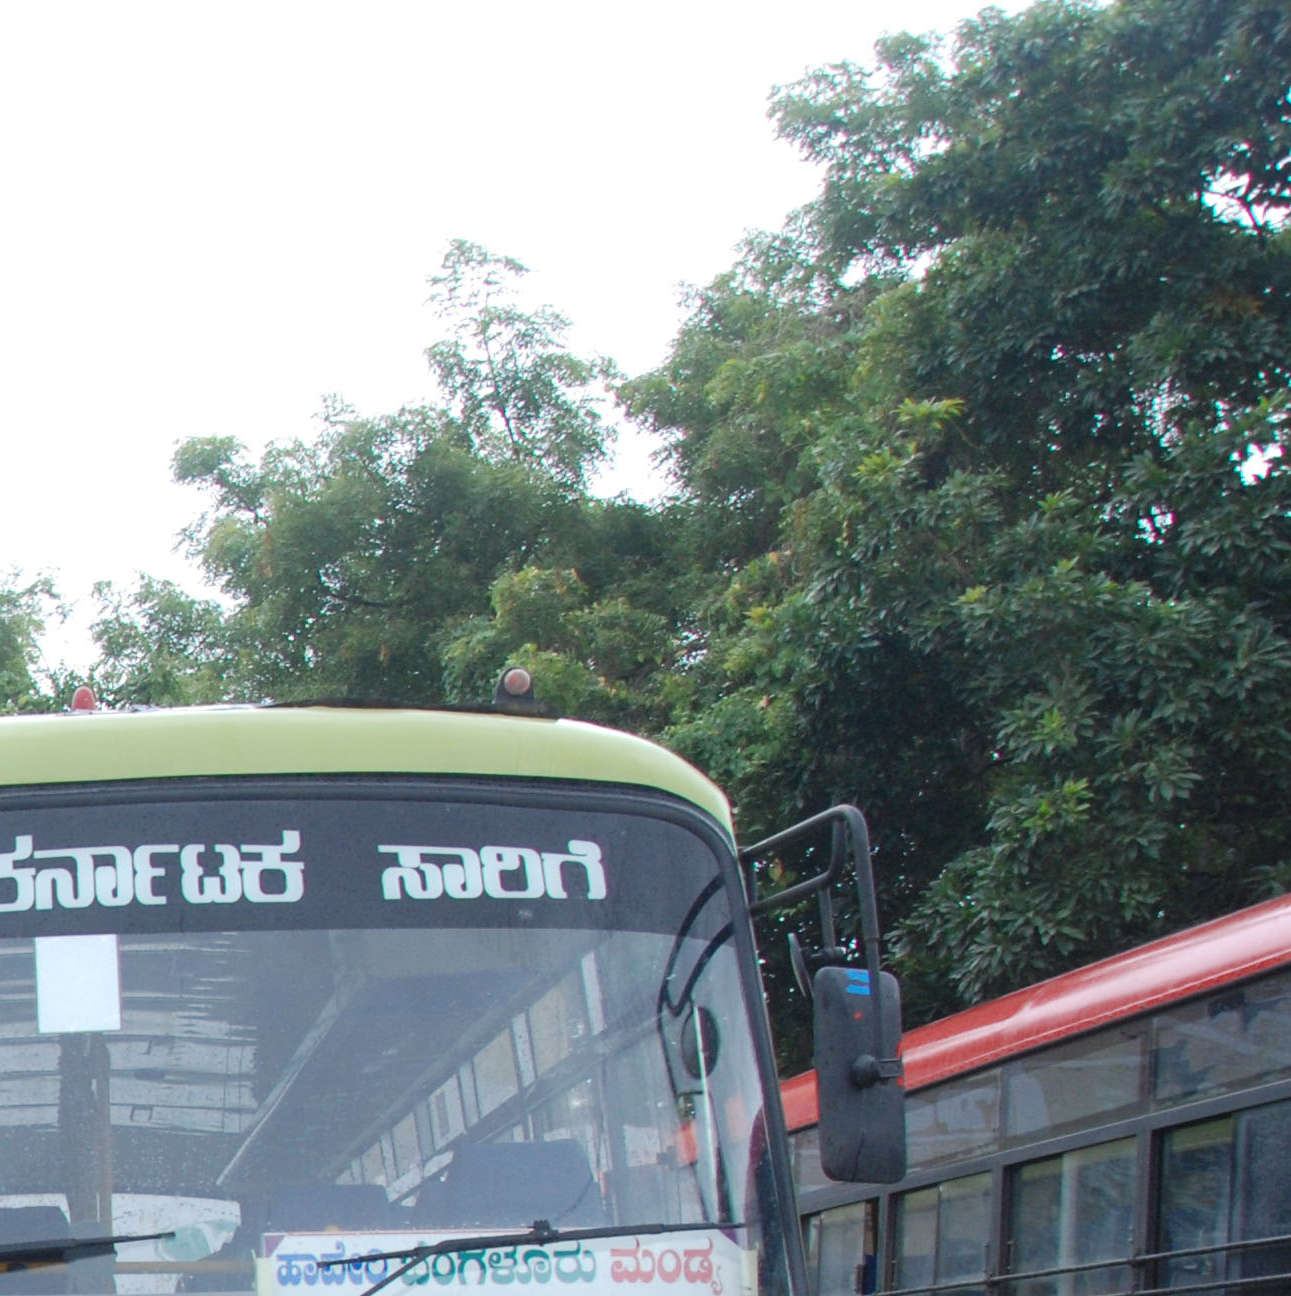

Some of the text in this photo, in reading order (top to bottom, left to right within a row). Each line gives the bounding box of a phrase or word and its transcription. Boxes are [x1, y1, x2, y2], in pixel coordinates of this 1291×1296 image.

[377, 839, 607, 900] ಸಾರಿಗೆ
[276, 1240, 388, 1287] ಹಾವೇರಿ
[610, 1237, 723, 1296] ಮಂಡ್ಯ
